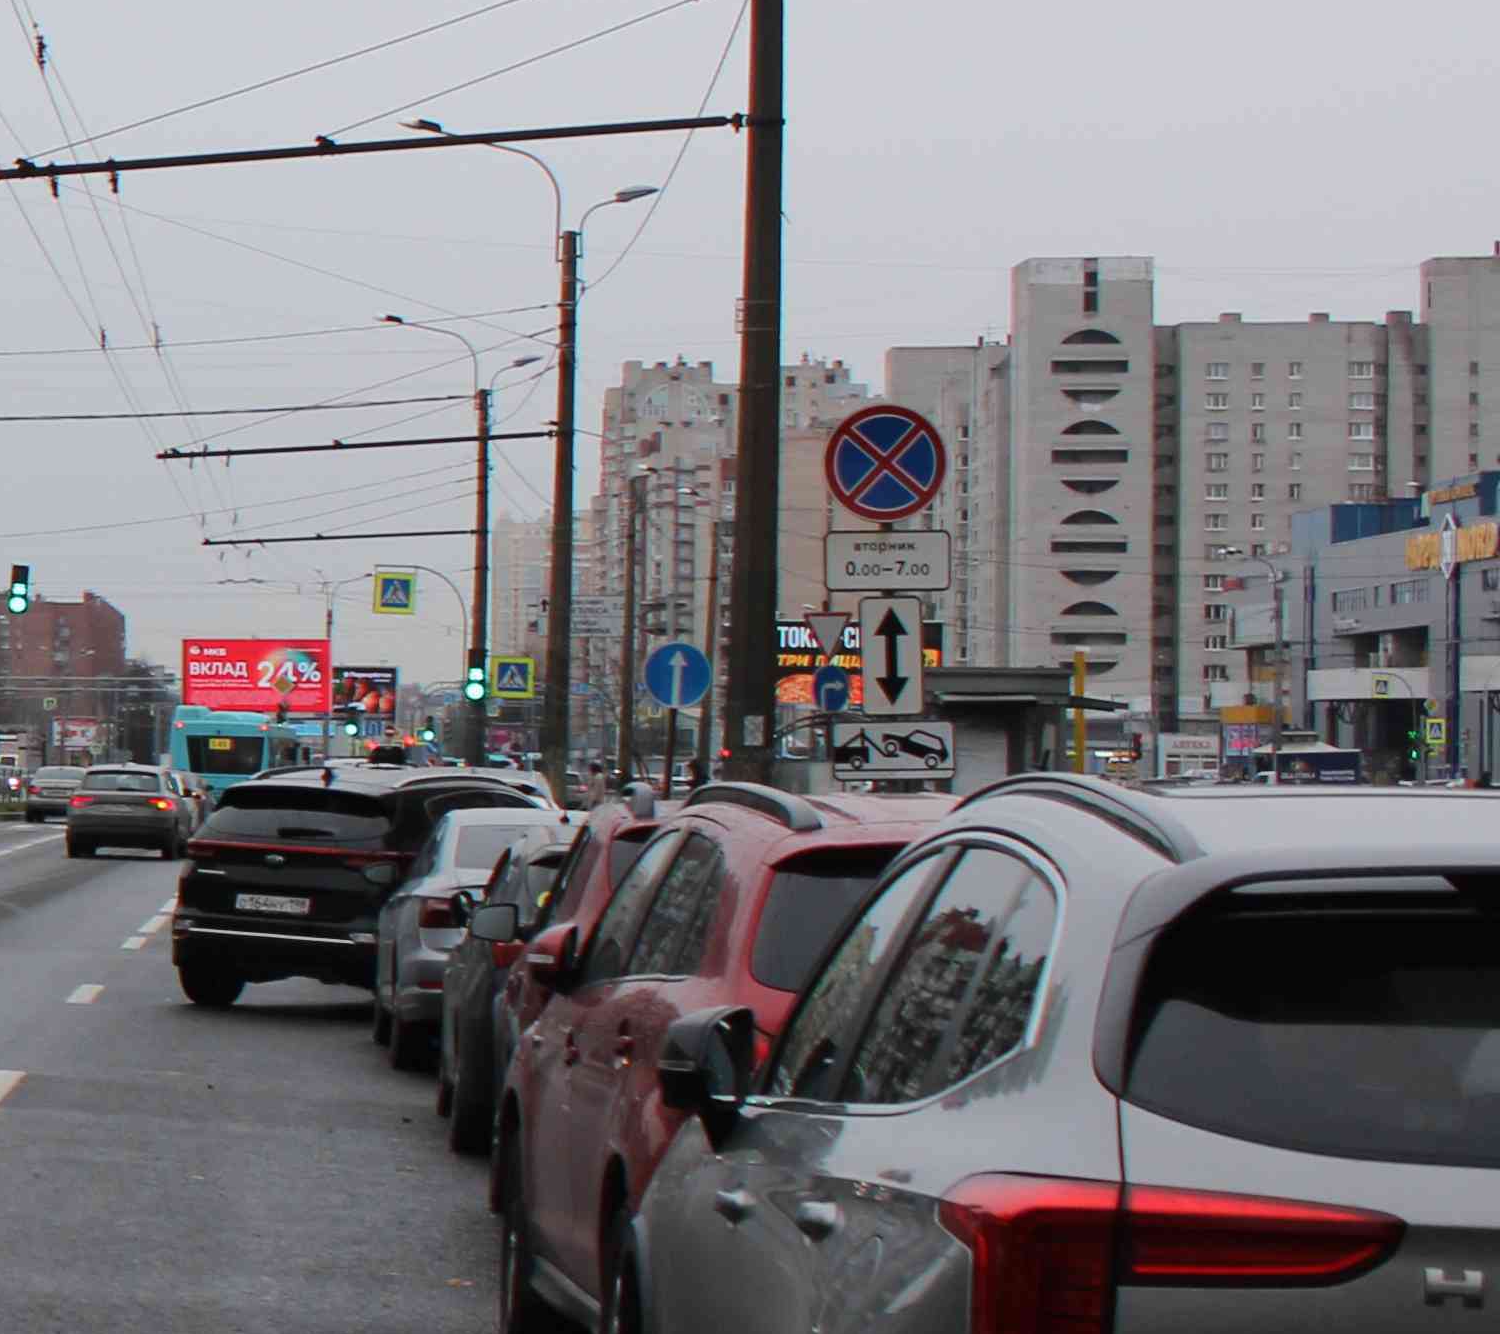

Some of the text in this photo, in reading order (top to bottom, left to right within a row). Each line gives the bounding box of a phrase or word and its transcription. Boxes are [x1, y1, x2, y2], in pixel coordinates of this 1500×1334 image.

[853, 542, 916, 553] вторник
[189, 661, 248, 677] ВКЛАД
[257, 661, 322, 687] 24%
